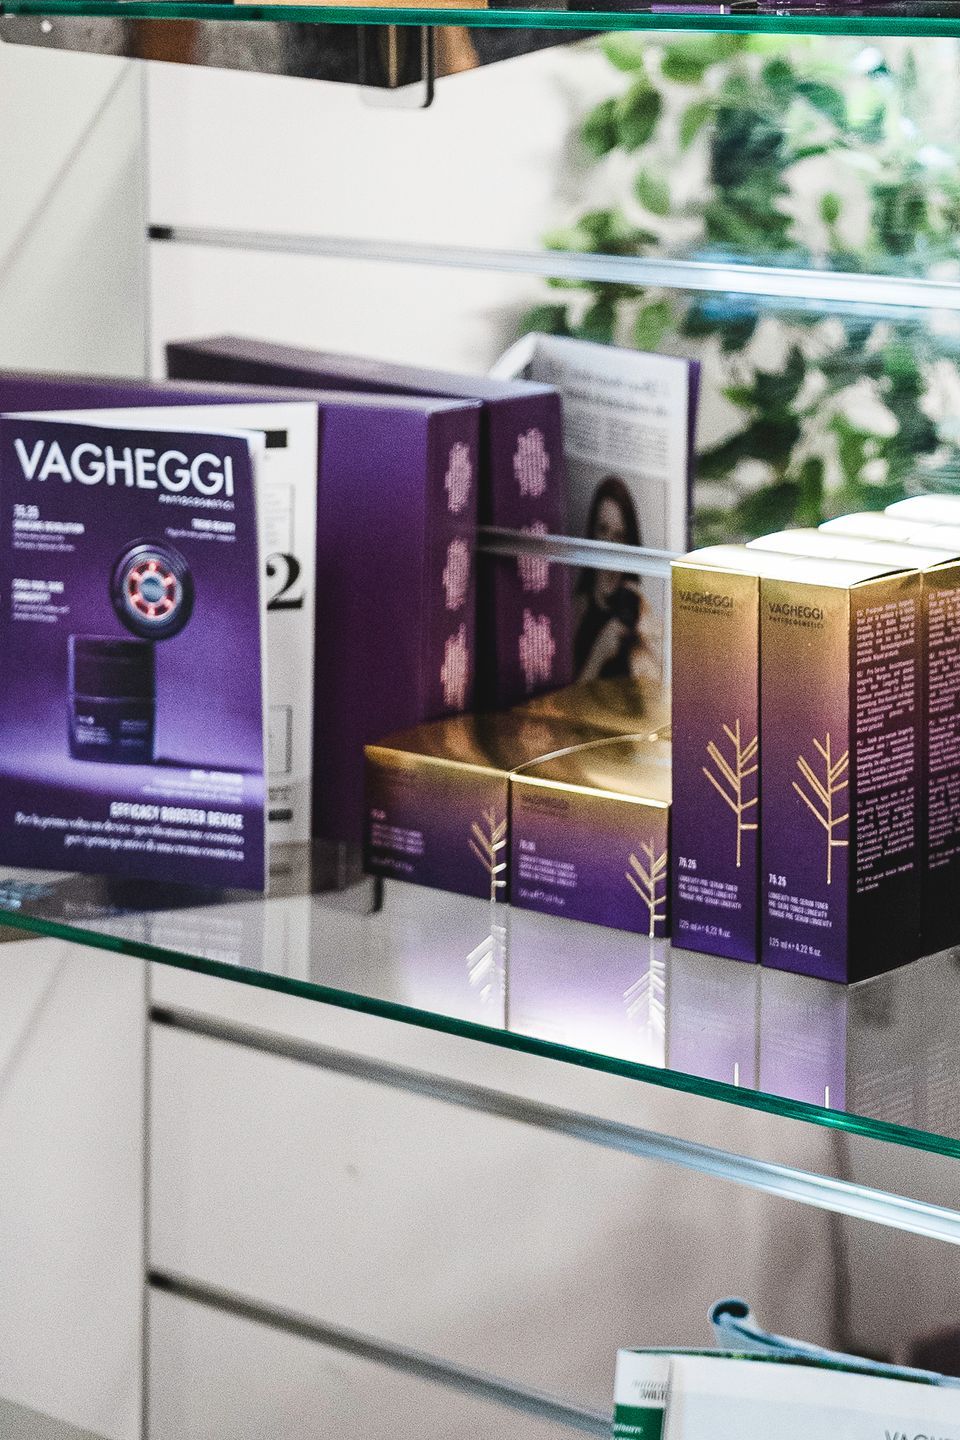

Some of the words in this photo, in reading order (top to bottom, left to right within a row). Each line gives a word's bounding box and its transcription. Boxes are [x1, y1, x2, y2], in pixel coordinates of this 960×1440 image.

[13, 438, 234, 497] VAGHEGGI
[679, 592, 733, 608] VAGHEGGI
[769, 603, 823, 620] VAGHEGGI
